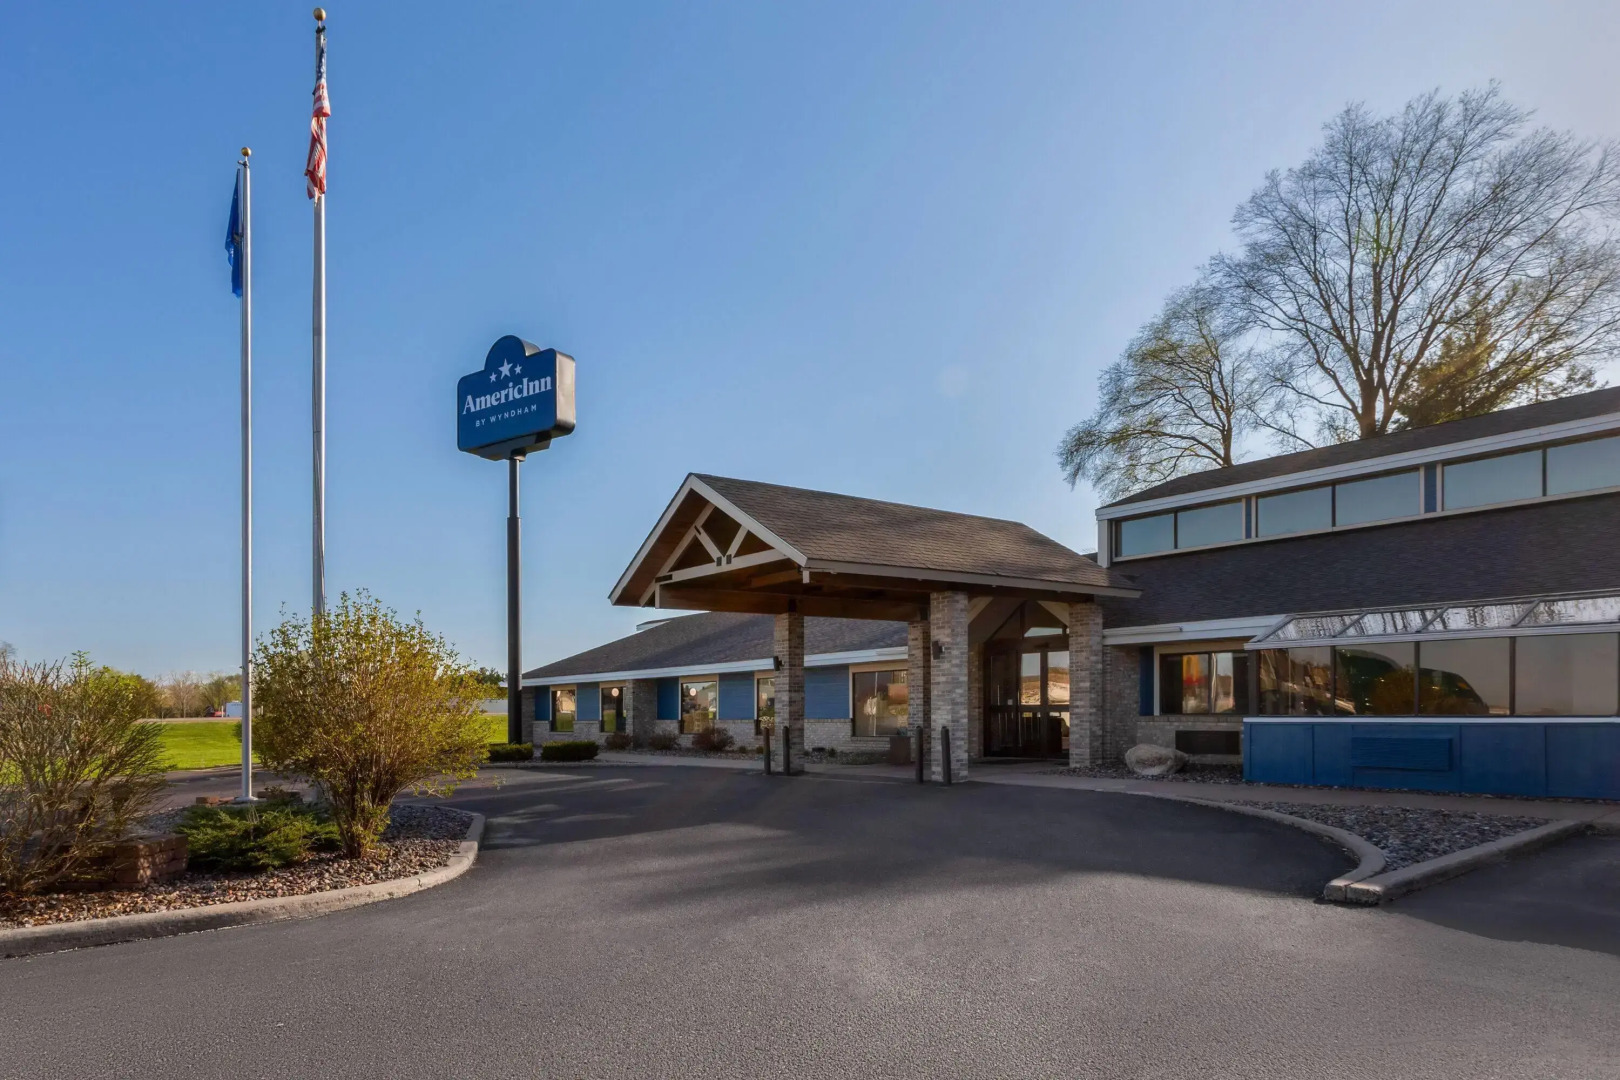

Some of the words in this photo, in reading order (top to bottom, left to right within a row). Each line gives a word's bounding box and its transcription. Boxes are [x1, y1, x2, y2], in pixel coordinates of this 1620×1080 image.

[462, 376, 552, 415] AmericInn
[475, 418, 486, 427] BY
[489, 404, 537, 423] WYNDHAM
